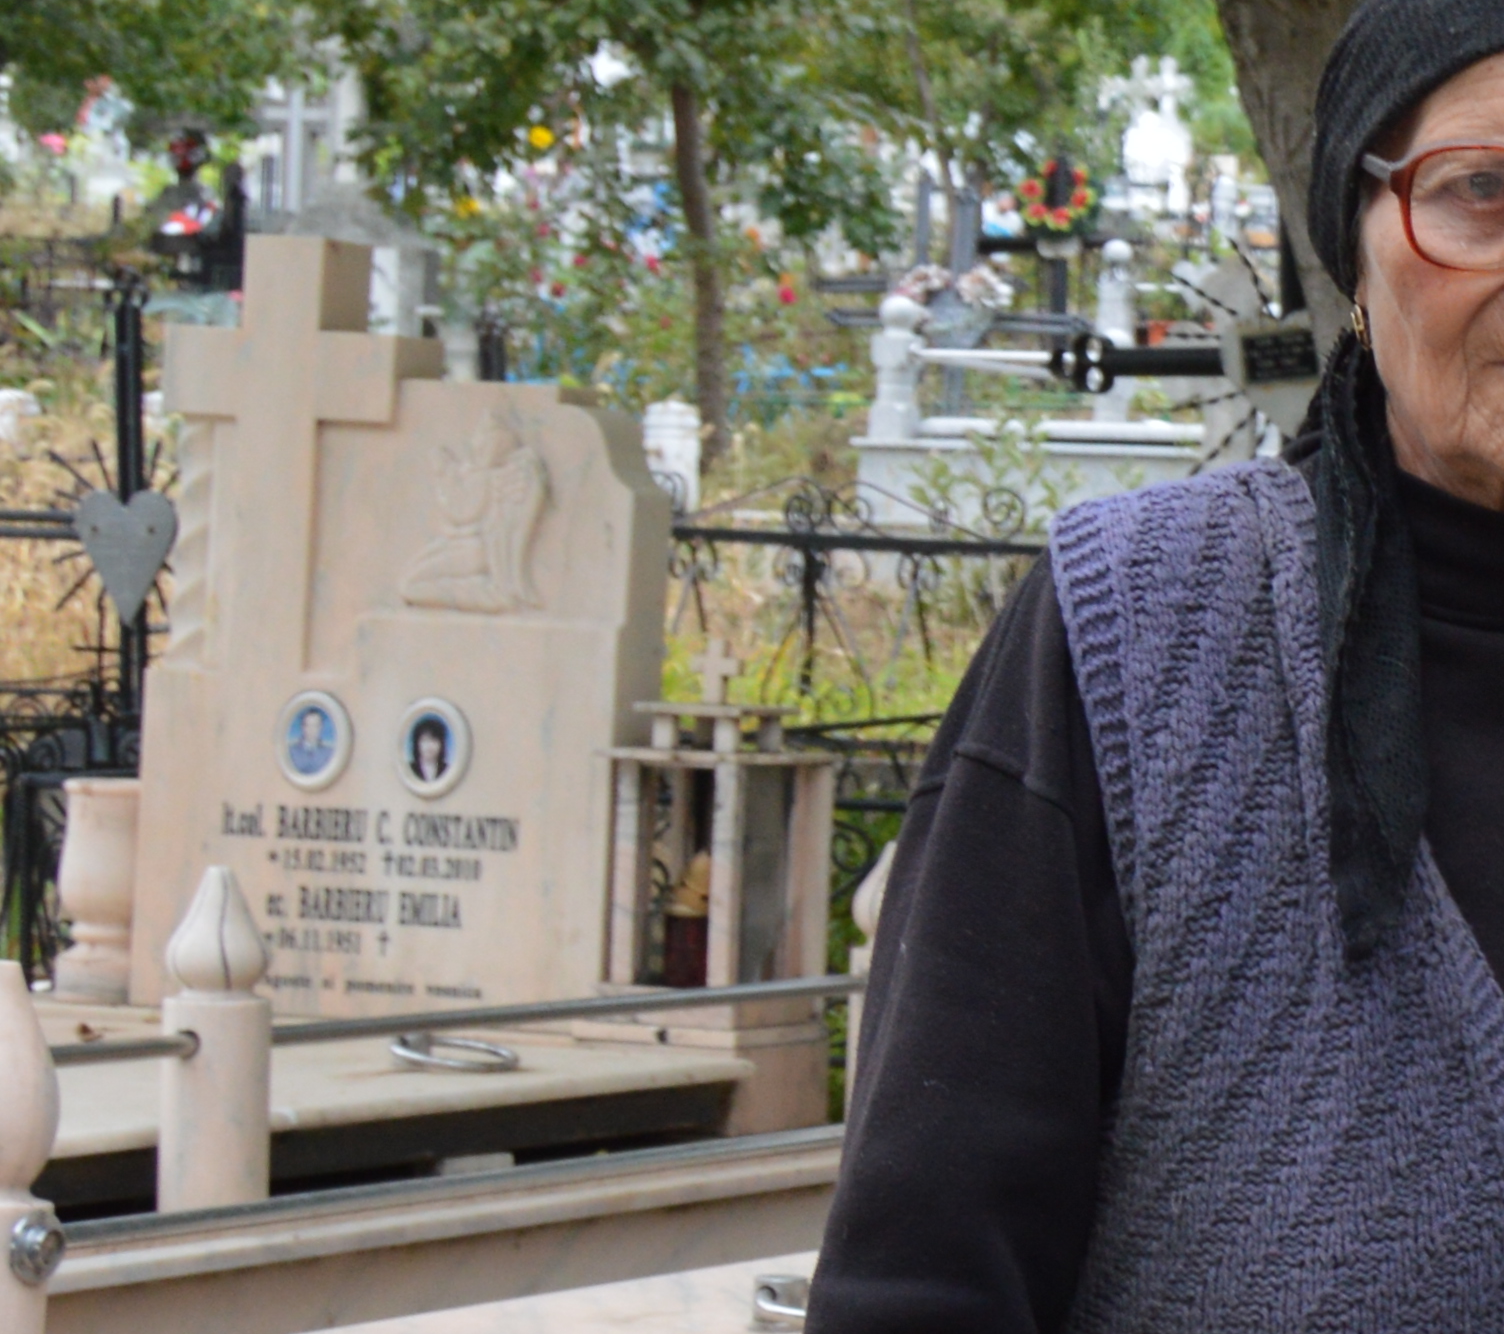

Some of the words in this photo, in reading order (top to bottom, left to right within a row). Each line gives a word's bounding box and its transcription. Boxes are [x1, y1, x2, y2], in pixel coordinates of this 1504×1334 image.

[276, 804, 368, 842] BARBIERU
[403, 812, 520, 852] CONSTANTIN
[398, 891, 462, 928] EMILIA
